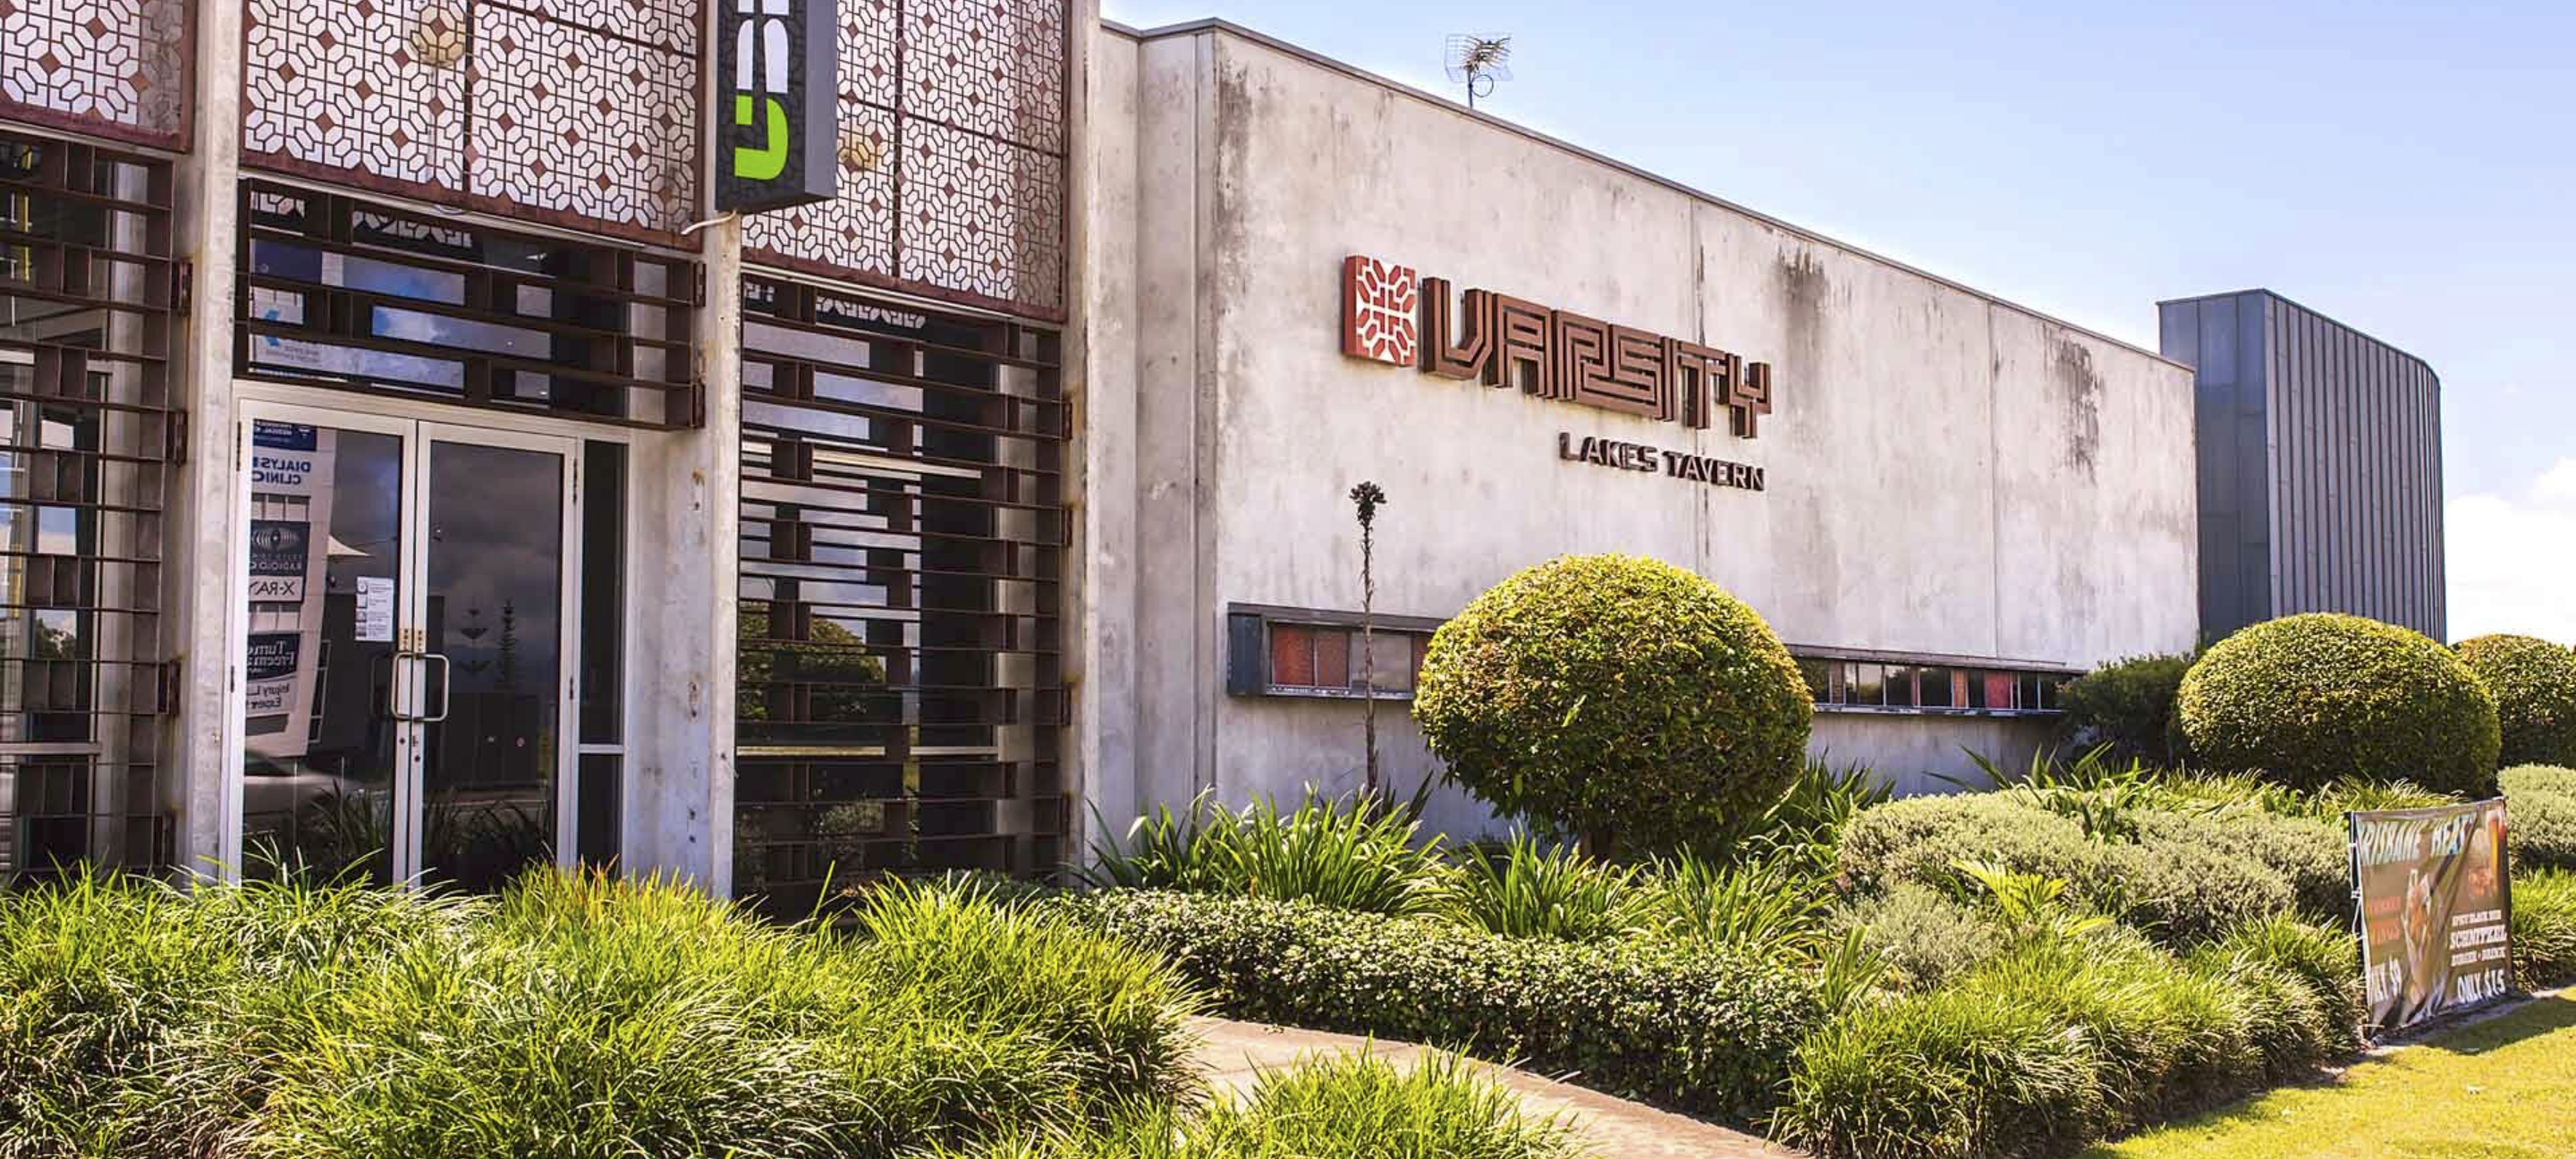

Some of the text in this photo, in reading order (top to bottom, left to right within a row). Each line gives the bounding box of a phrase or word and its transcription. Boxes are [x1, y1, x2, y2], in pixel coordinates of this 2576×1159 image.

[733, 0, 789, 180] UB
[1421, 276, 1772, 438] VARSITY
[1559, 432, 1765, 491] LAKES TAVERN
